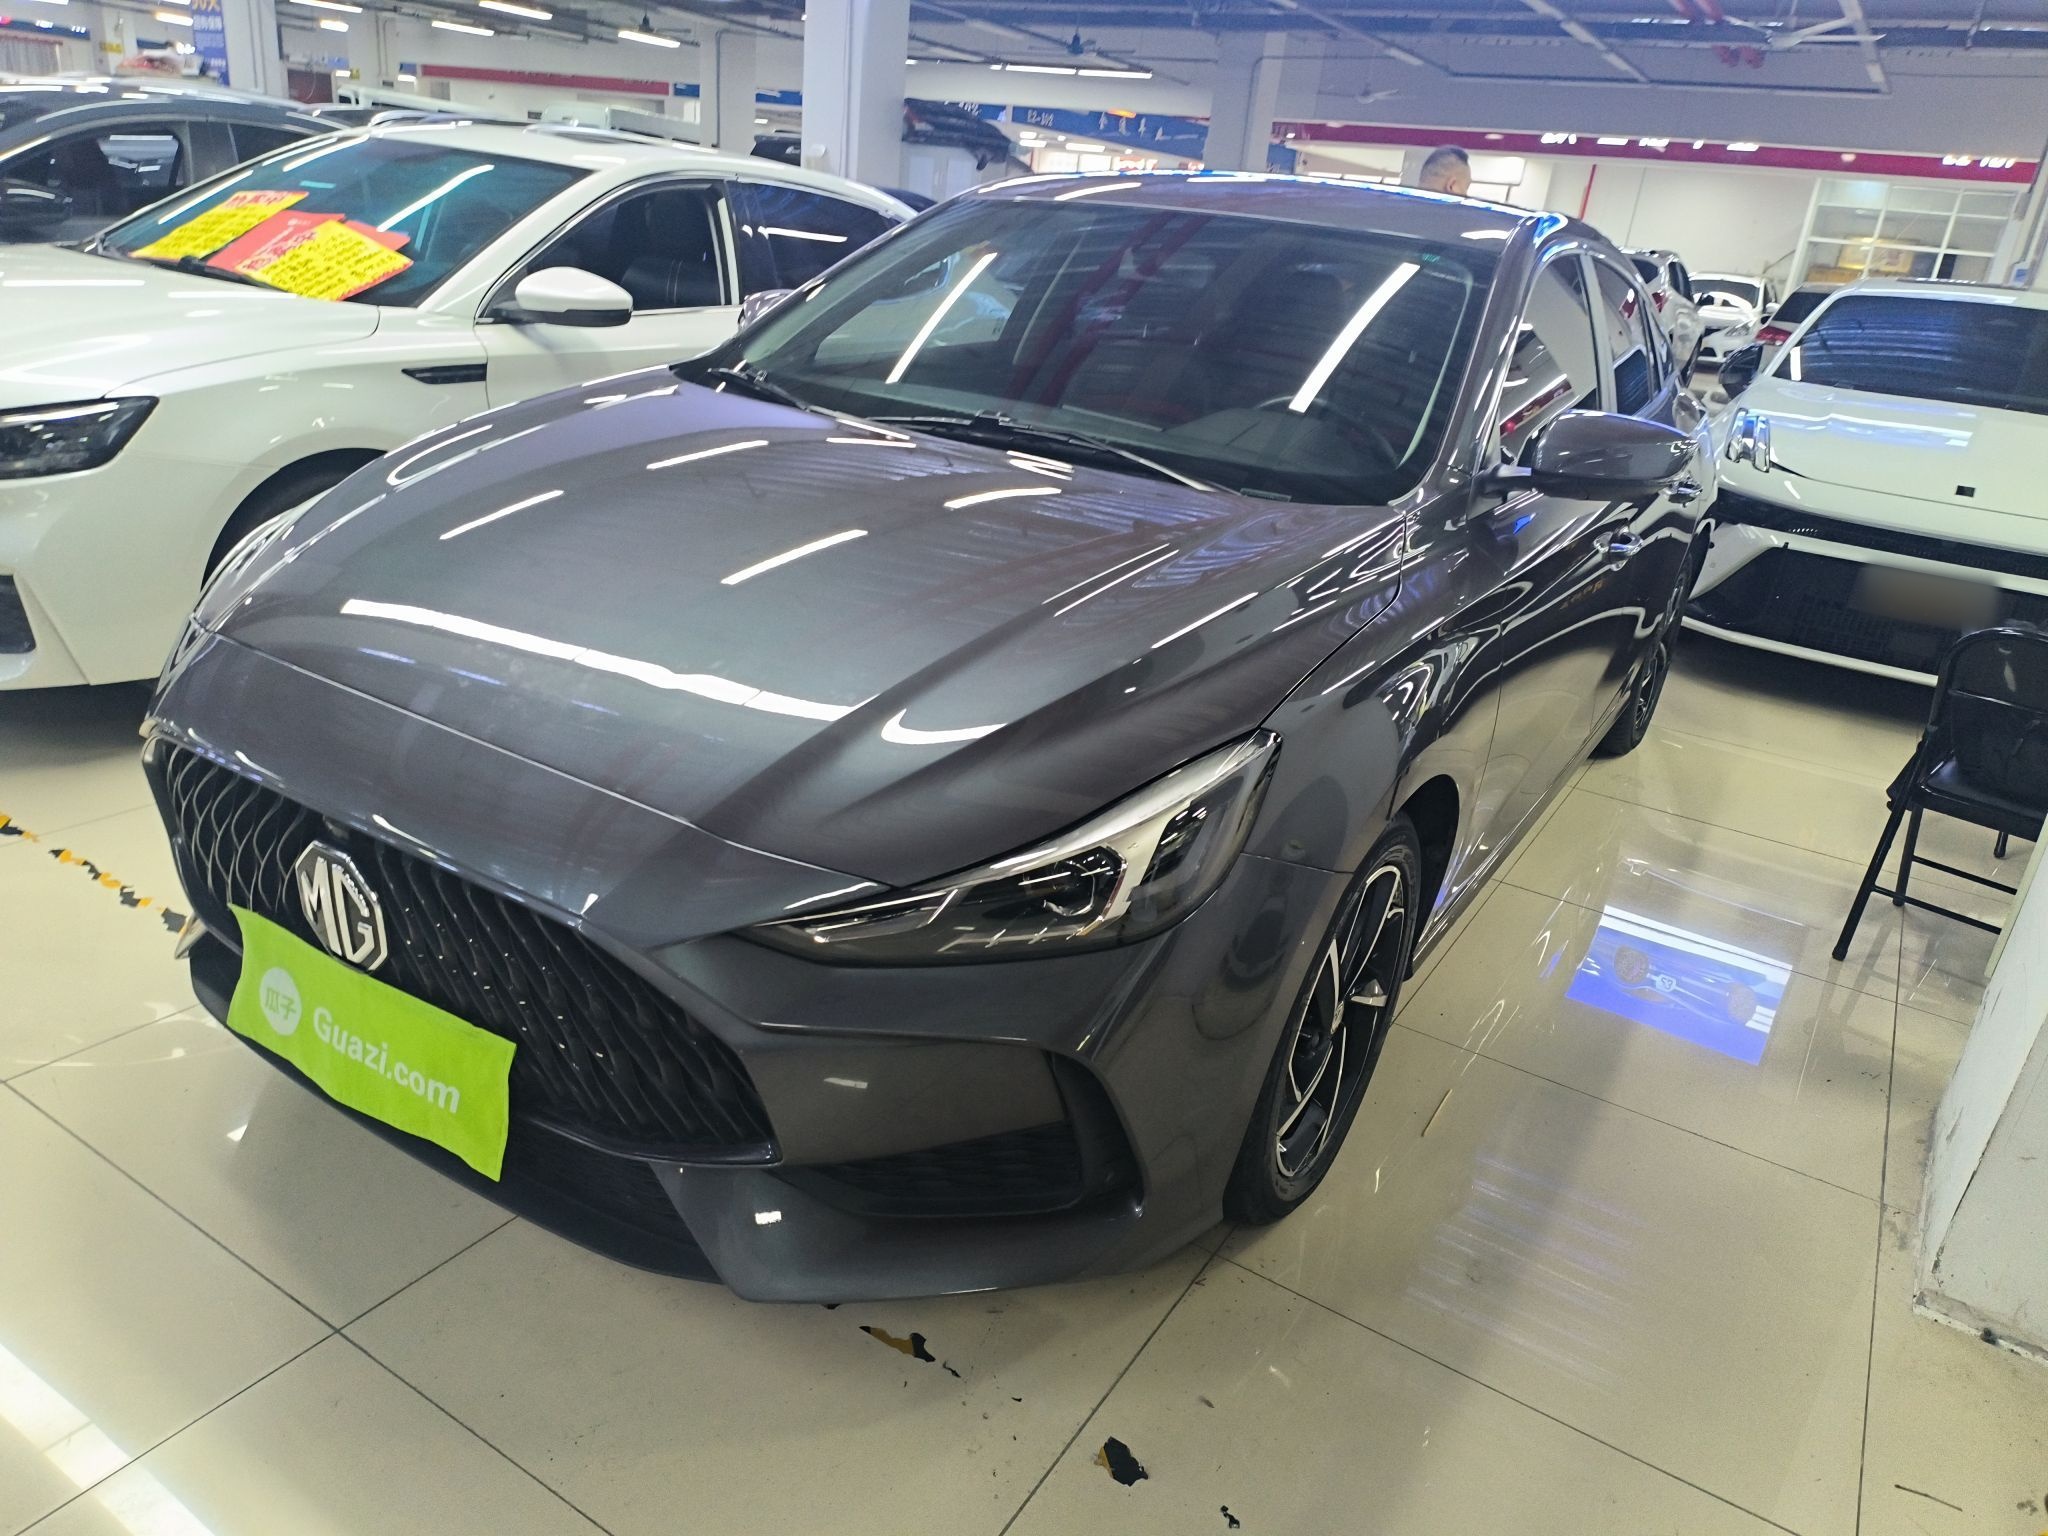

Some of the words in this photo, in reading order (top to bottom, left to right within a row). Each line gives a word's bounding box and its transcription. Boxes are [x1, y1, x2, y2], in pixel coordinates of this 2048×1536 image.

[301, 856, 375, 964] MG
[264, 987, 297, 1020] 瓜子
[313, 1006, 461, 1114] Guazi.com
